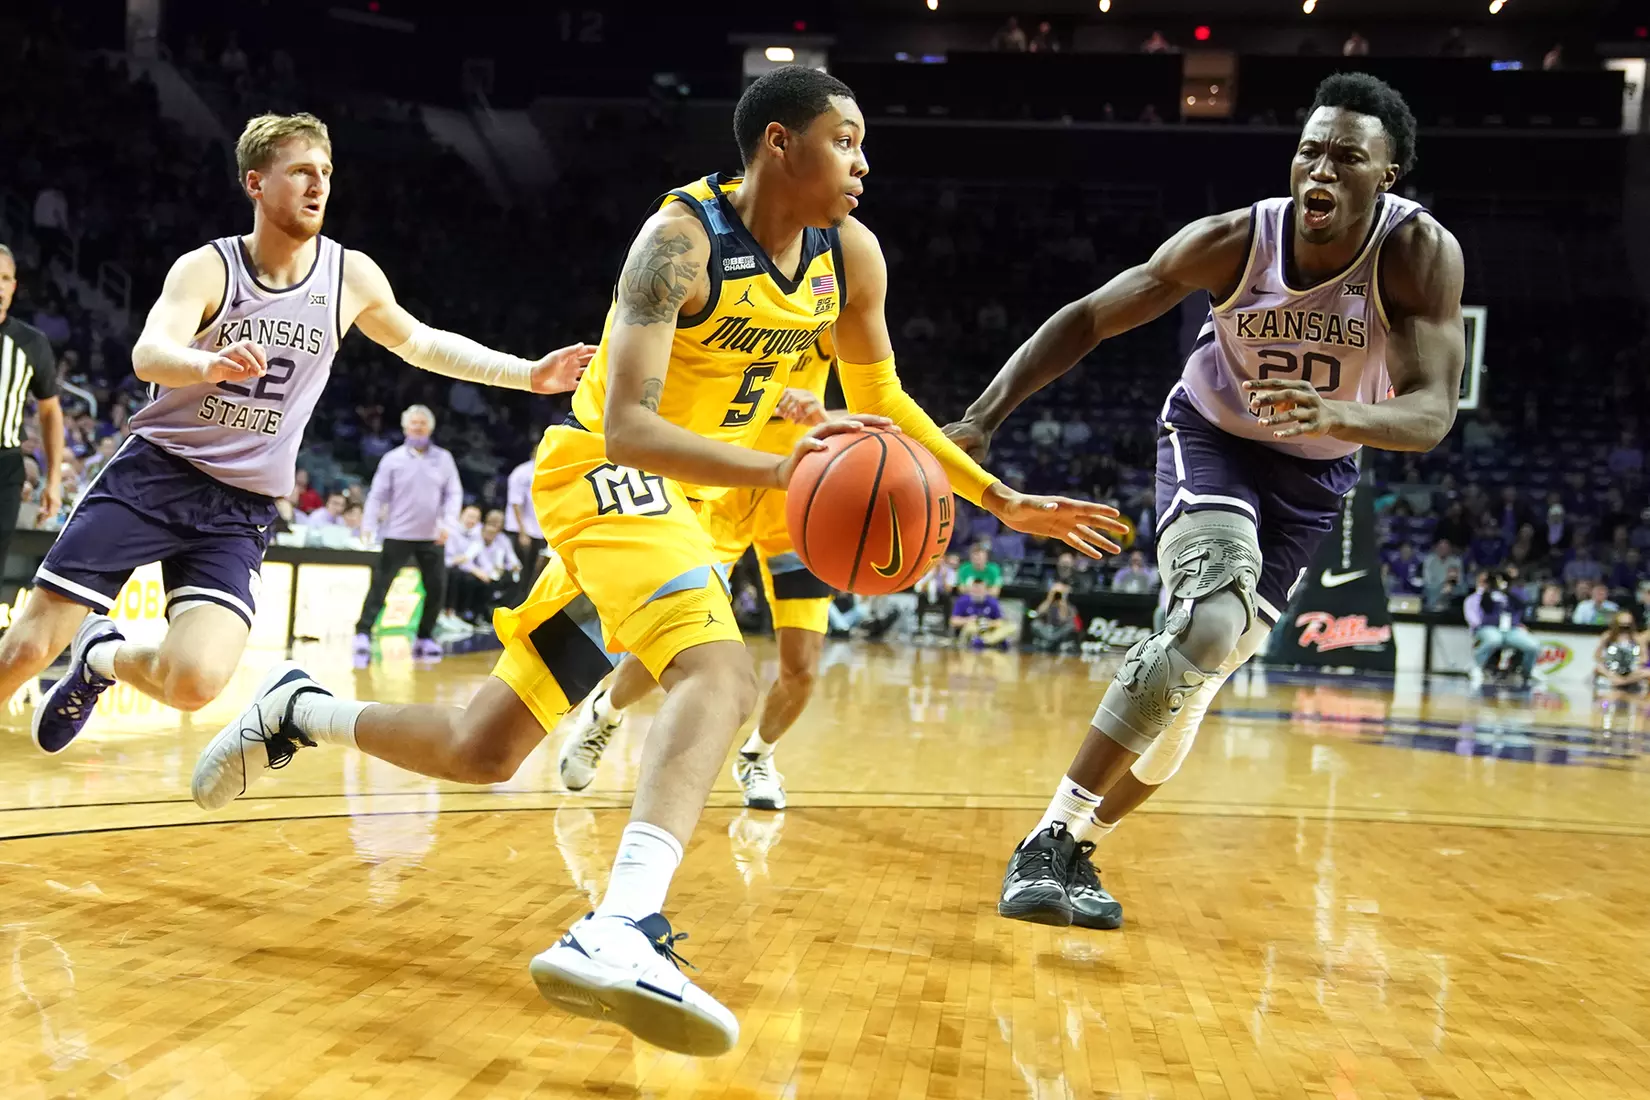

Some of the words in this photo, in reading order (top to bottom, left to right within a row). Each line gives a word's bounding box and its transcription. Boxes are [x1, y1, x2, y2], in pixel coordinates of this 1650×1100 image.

[557, 9, 604, 43] 12
[815, 302, 835, 313] EAST
[817, 297, 832, 305] BIG
[215, 319, 323, 355] KANSAS
[701, 316, 831, 360] Marquett
[1236, 310, 1366, 349] KANSAS
[1257, 350, 1341, 392] 20
[719, 361, 779, 427] 5
[200, 395, 282, 434] STATE
[584, 463, 672, 516] MU
